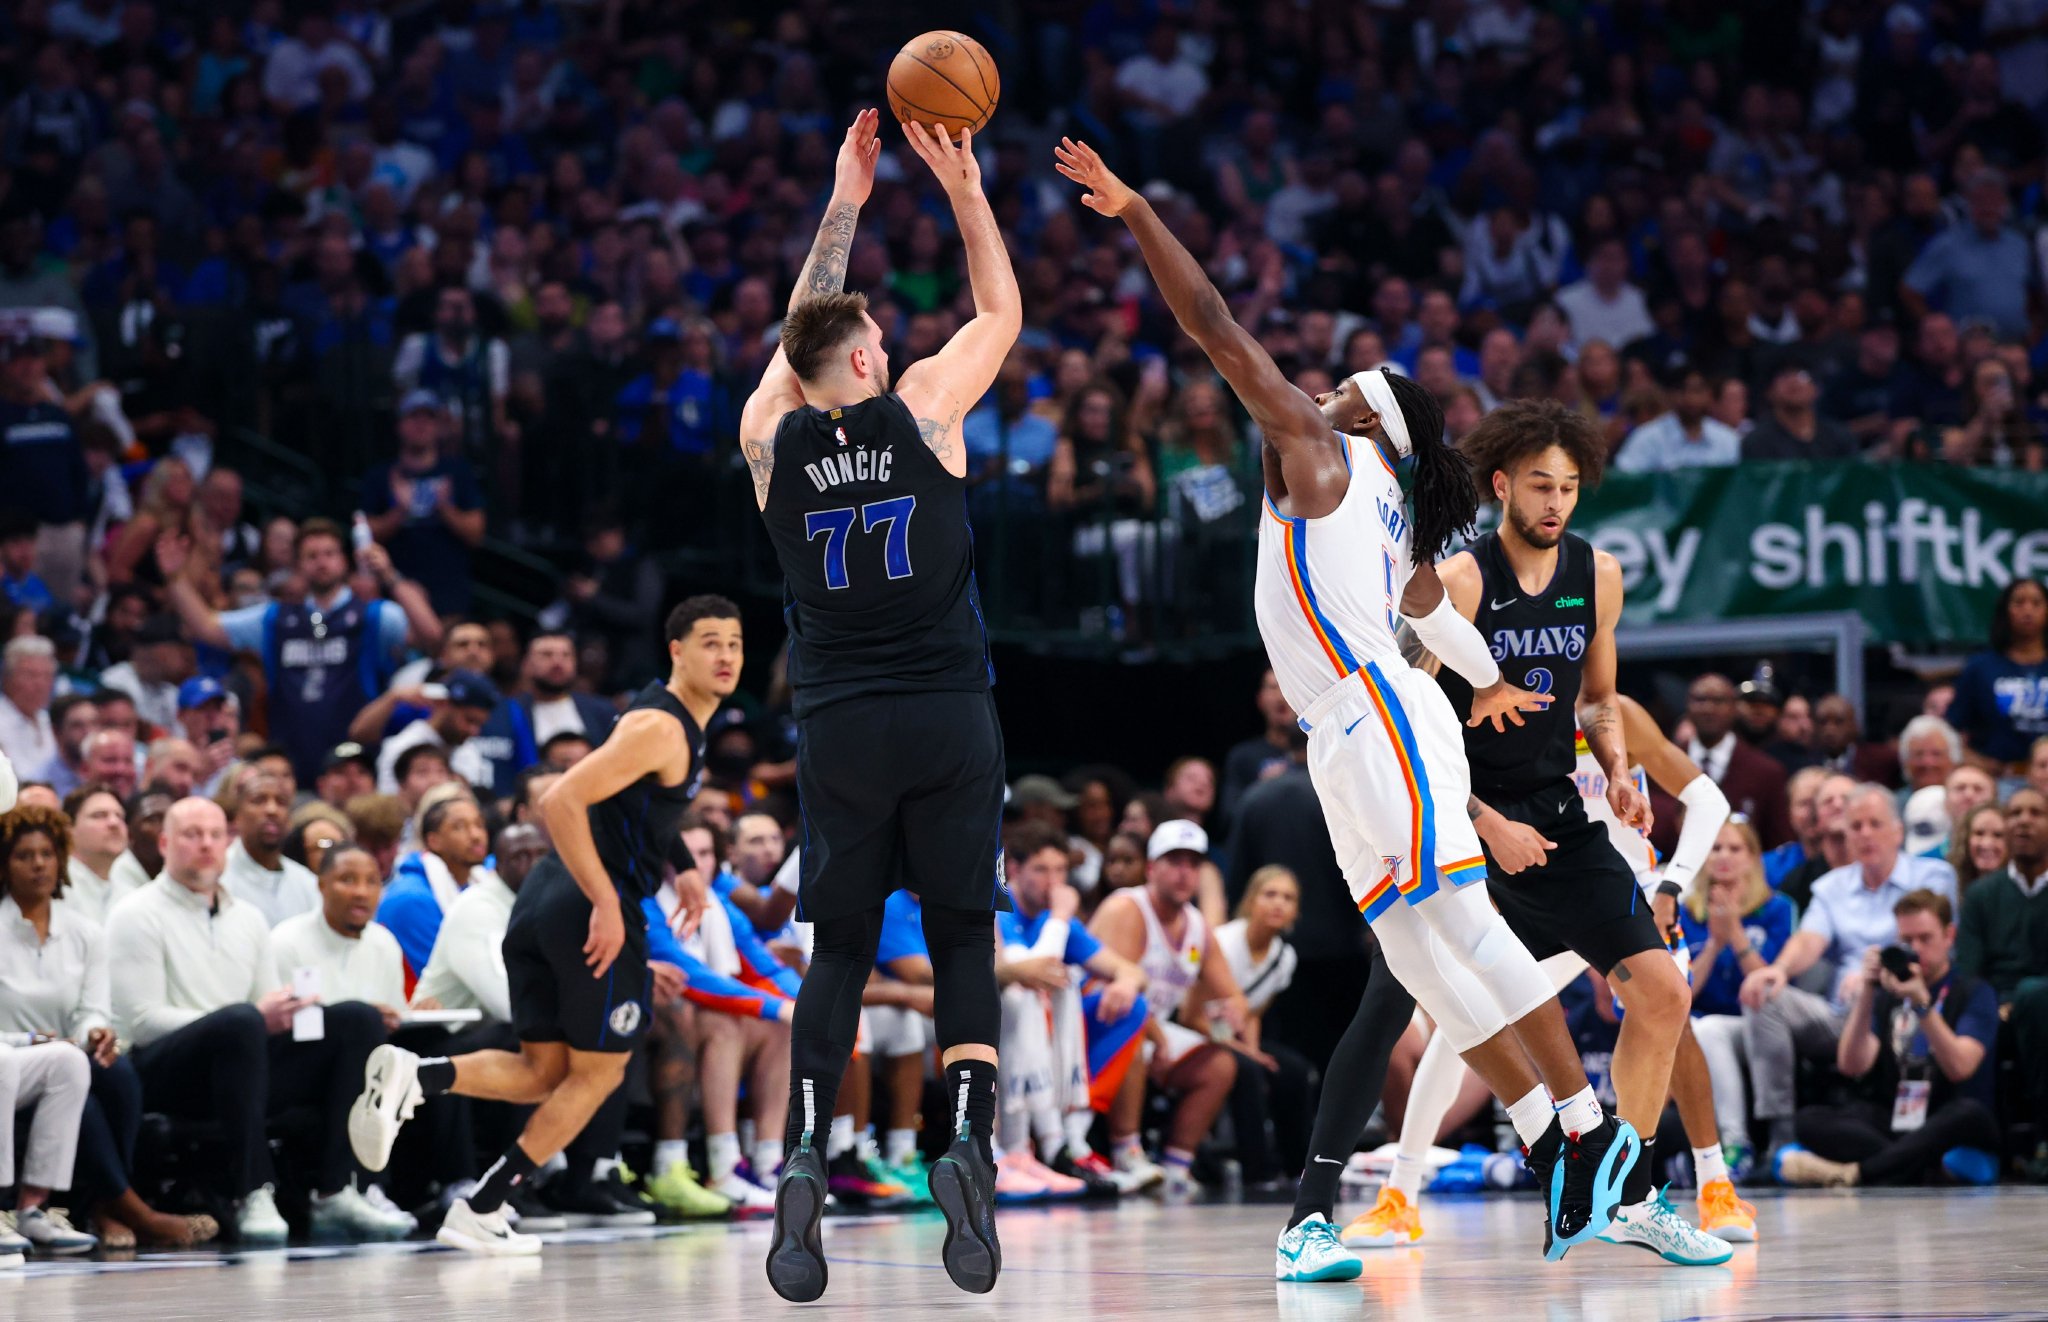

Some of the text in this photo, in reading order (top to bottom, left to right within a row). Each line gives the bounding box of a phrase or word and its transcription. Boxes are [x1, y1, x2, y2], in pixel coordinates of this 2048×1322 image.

[804, 445, 893, 493] DONČIĆ
[804, 495, 916, 590] 77
[1555, 596, 1585, 608] chime
[1489, 624, 1586, 662] MAVS
[1519, 667, 1553, 711] 2
